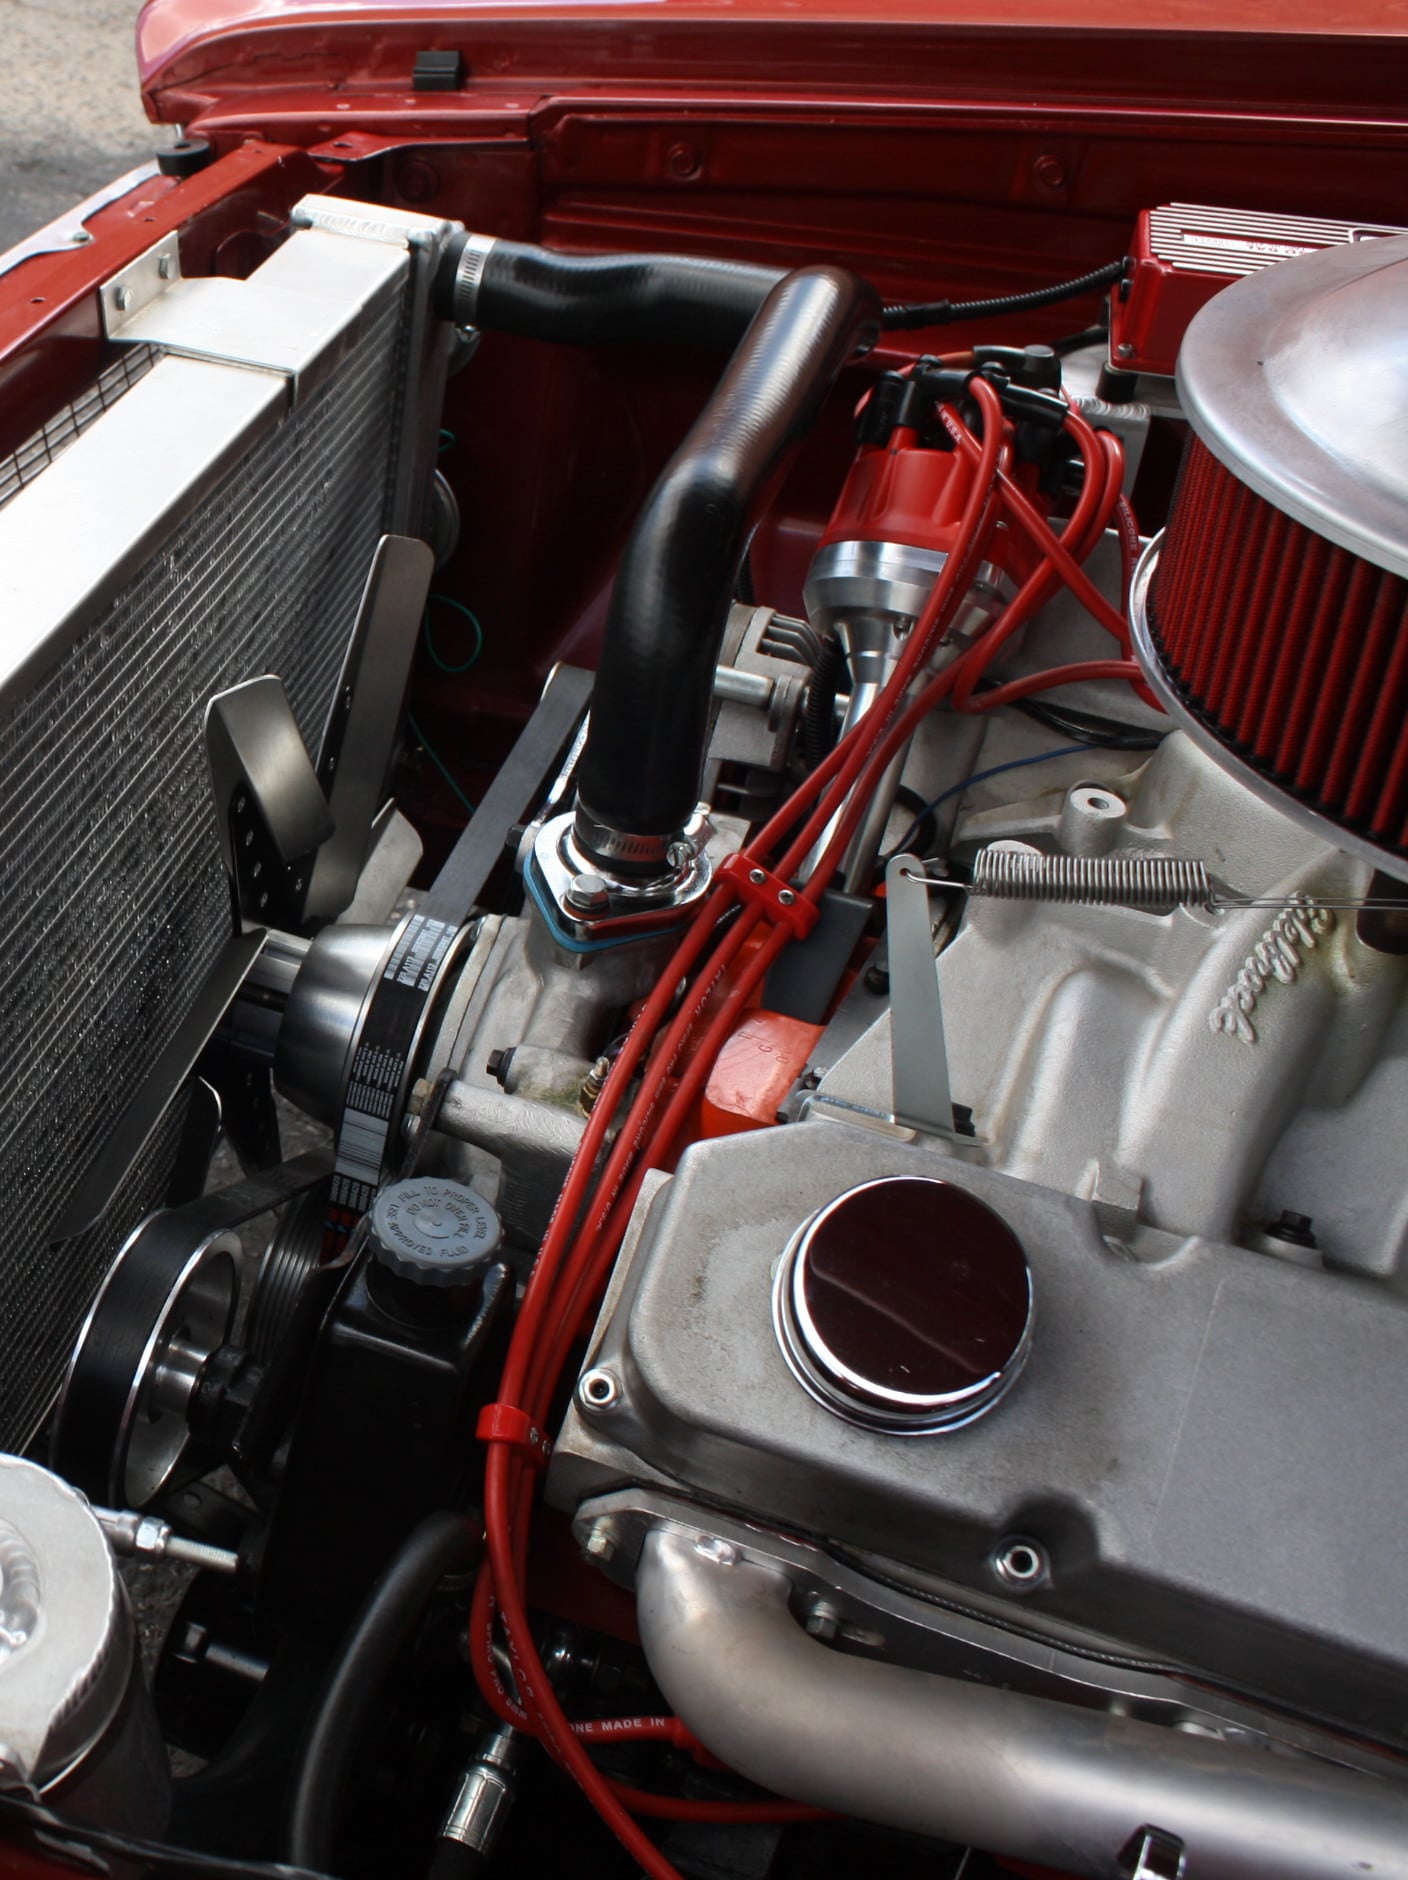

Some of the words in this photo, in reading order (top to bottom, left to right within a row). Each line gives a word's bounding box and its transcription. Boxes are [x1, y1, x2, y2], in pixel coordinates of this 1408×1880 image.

[1209, 889, 1335, 1042] Edelbrock
[398, 1190, 421, 1202] FILL
[424, 1186, 438, 1195] TO
[443, 1189, 480, 1214] PROPER
[406, 1203, 421, 1216] DO
[419, 1198, 441, 1208] NOT
[388, 1222, 433, 1256] APPROVED
[440, 1245, 469, 1257] FLUID
[601, 1718, 642, 1731] MADE
[650, 1717, 665, 1727] IN
